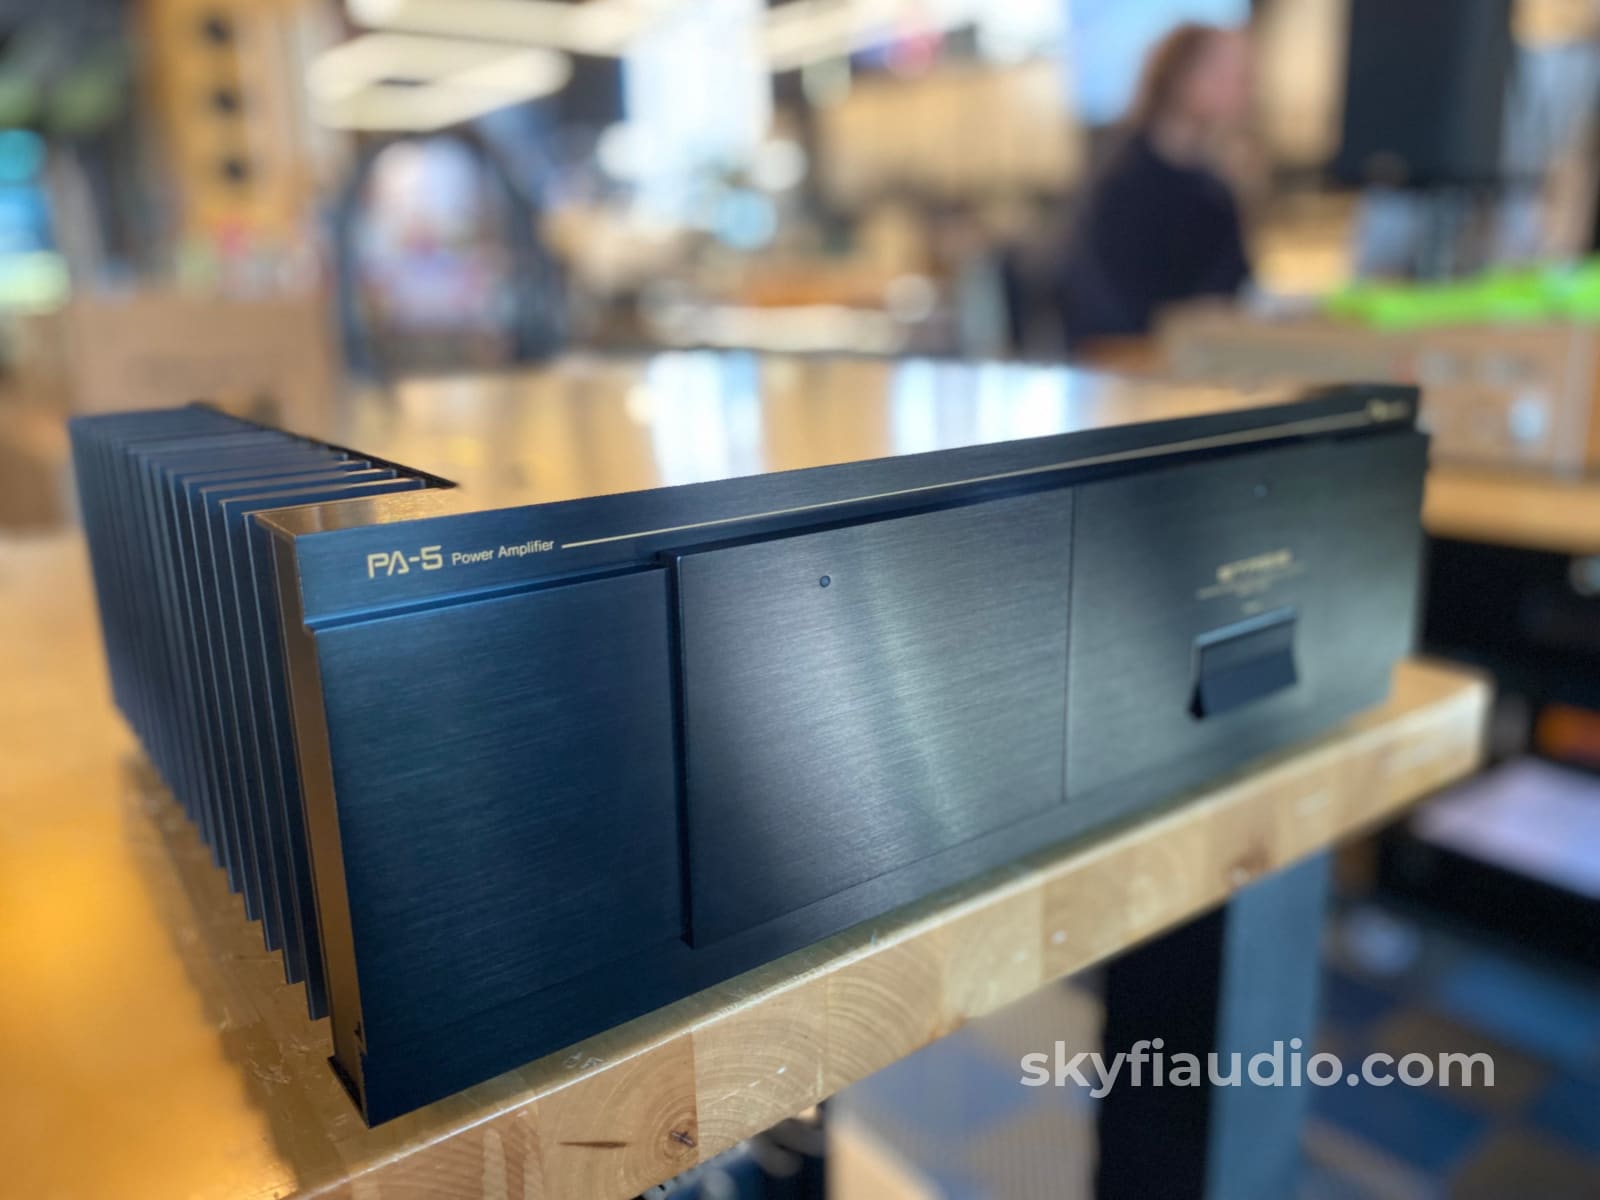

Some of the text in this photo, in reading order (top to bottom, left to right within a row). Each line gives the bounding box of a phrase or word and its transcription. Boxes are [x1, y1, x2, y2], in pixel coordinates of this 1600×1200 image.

[367, 540, 554, 578] PA-5 Power Amplifier
